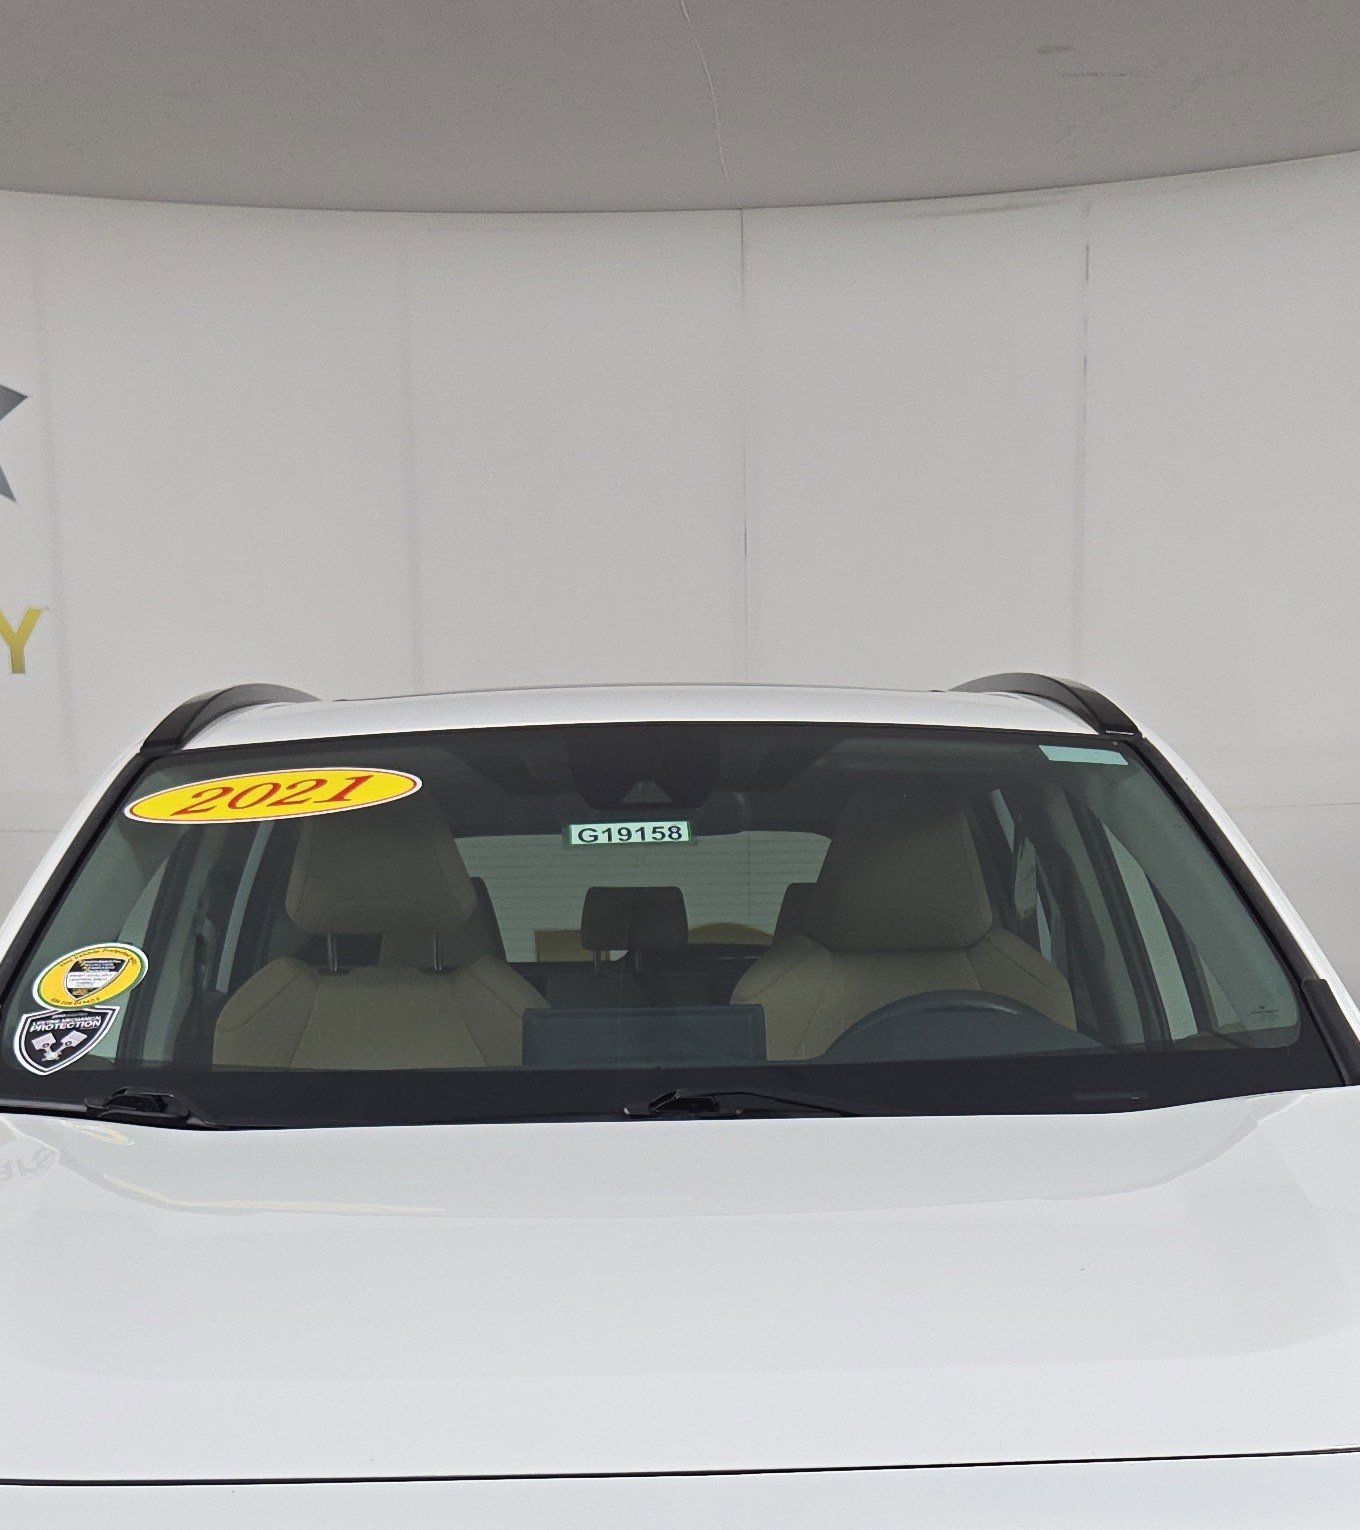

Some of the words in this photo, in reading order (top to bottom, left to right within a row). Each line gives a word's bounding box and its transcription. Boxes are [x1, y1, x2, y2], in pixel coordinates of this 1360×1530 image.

[170, 774, 375, 816] 2021
[577, 825, 683, 843] G19158
[29, 1020, 102, 1033] PROTECTION
